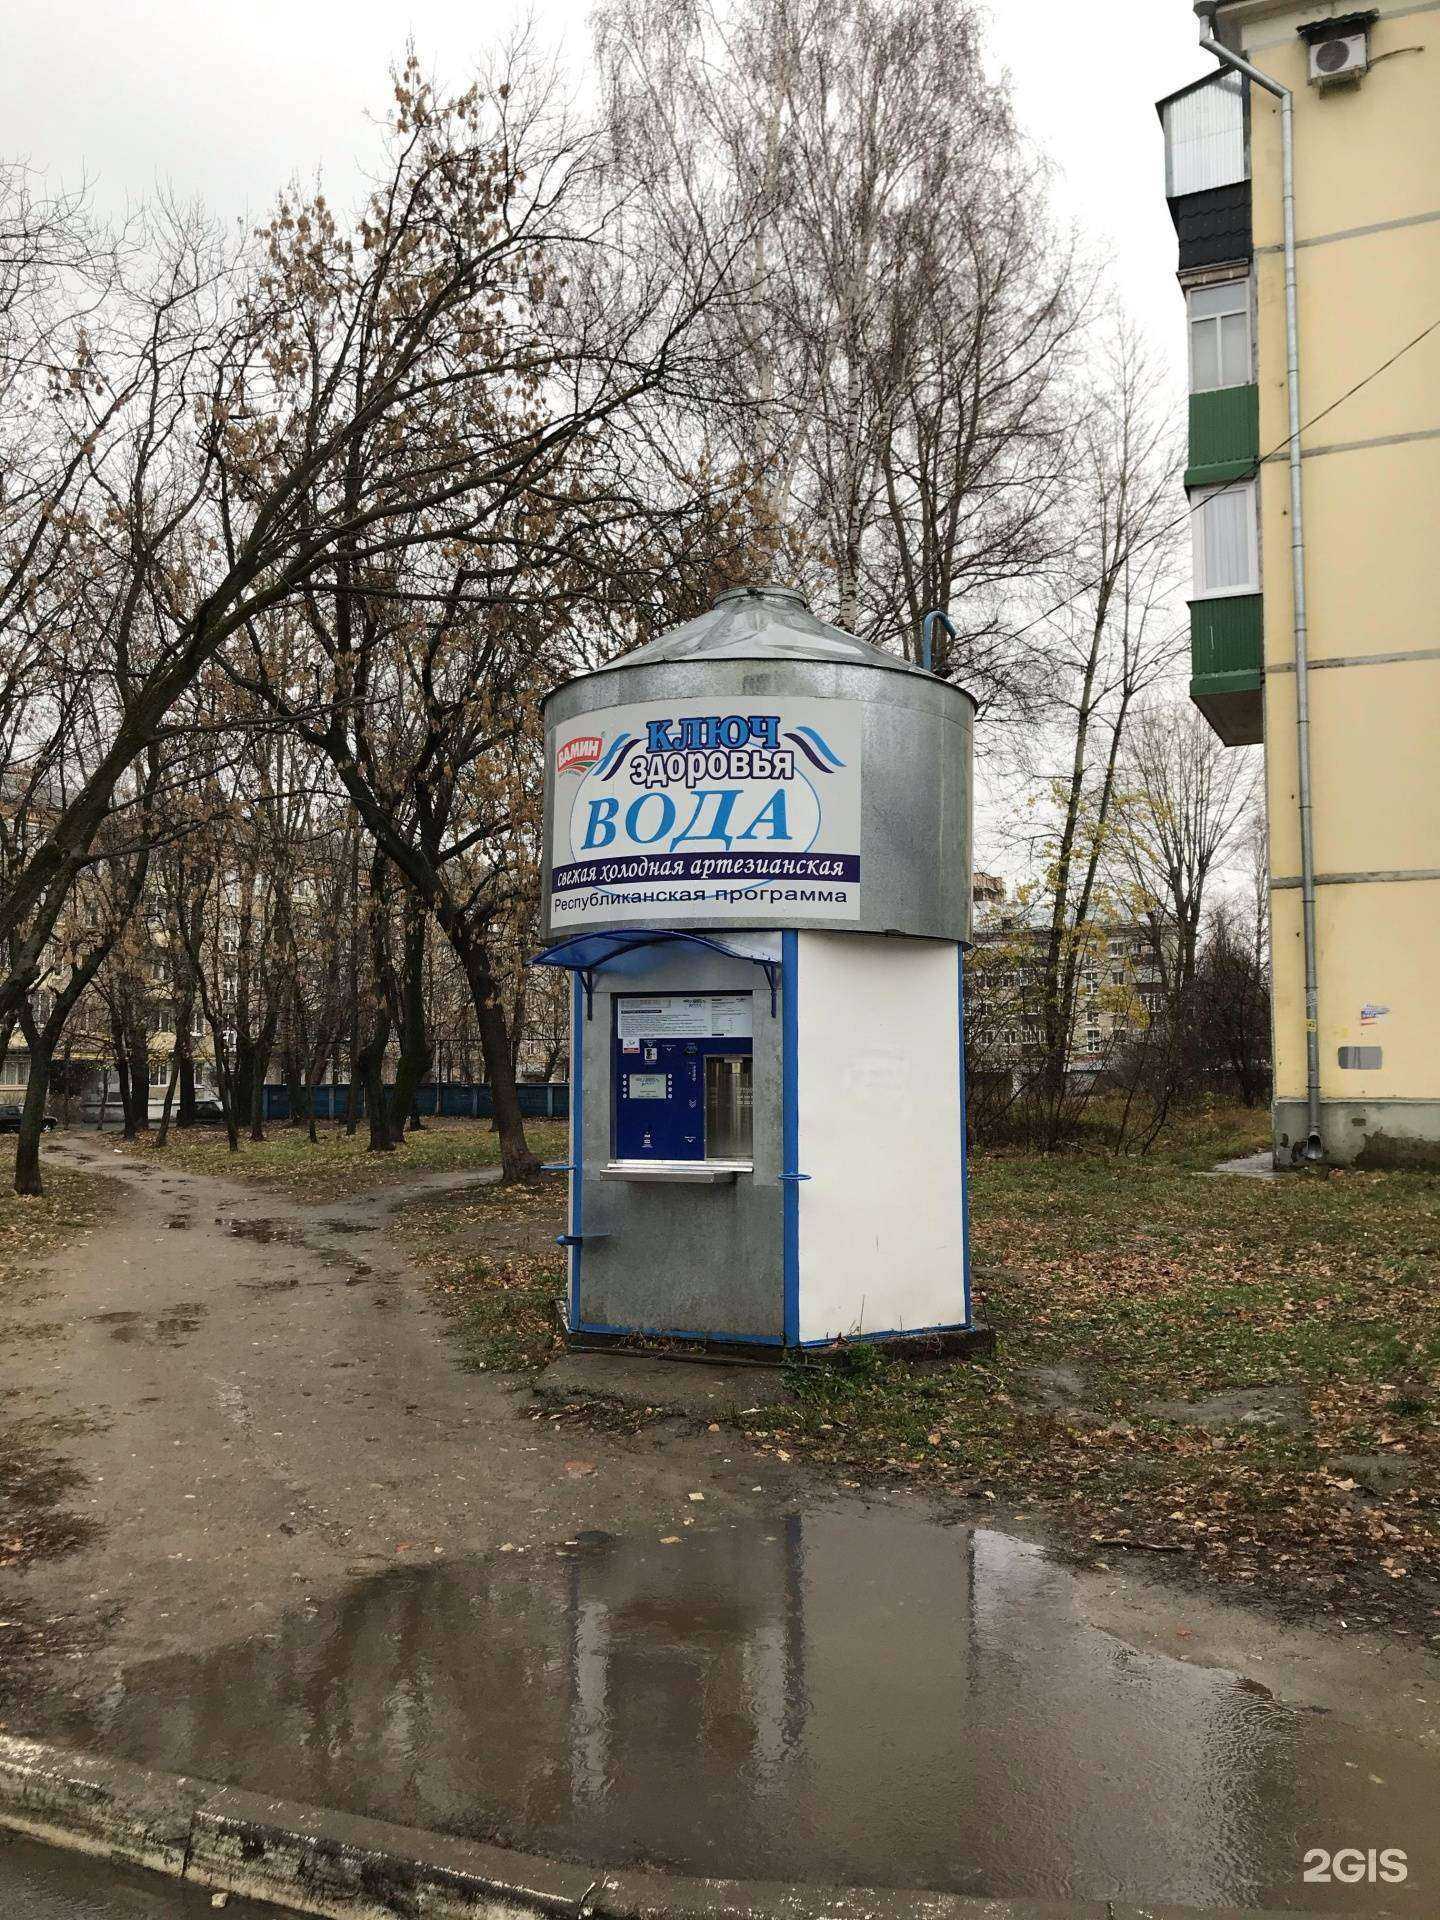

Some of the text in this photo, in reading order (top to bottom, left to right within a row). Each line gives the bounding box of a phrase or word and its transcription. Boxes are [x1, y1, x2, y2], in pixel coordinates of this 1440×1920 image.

[646, 715, 780, 753] КЛЮЧ
[581, 788, 793, 852] ВОДА
[557, 856, 844, 887] свежая холодная артезианская
[554, 889, 847, 912] Республиканская программа
